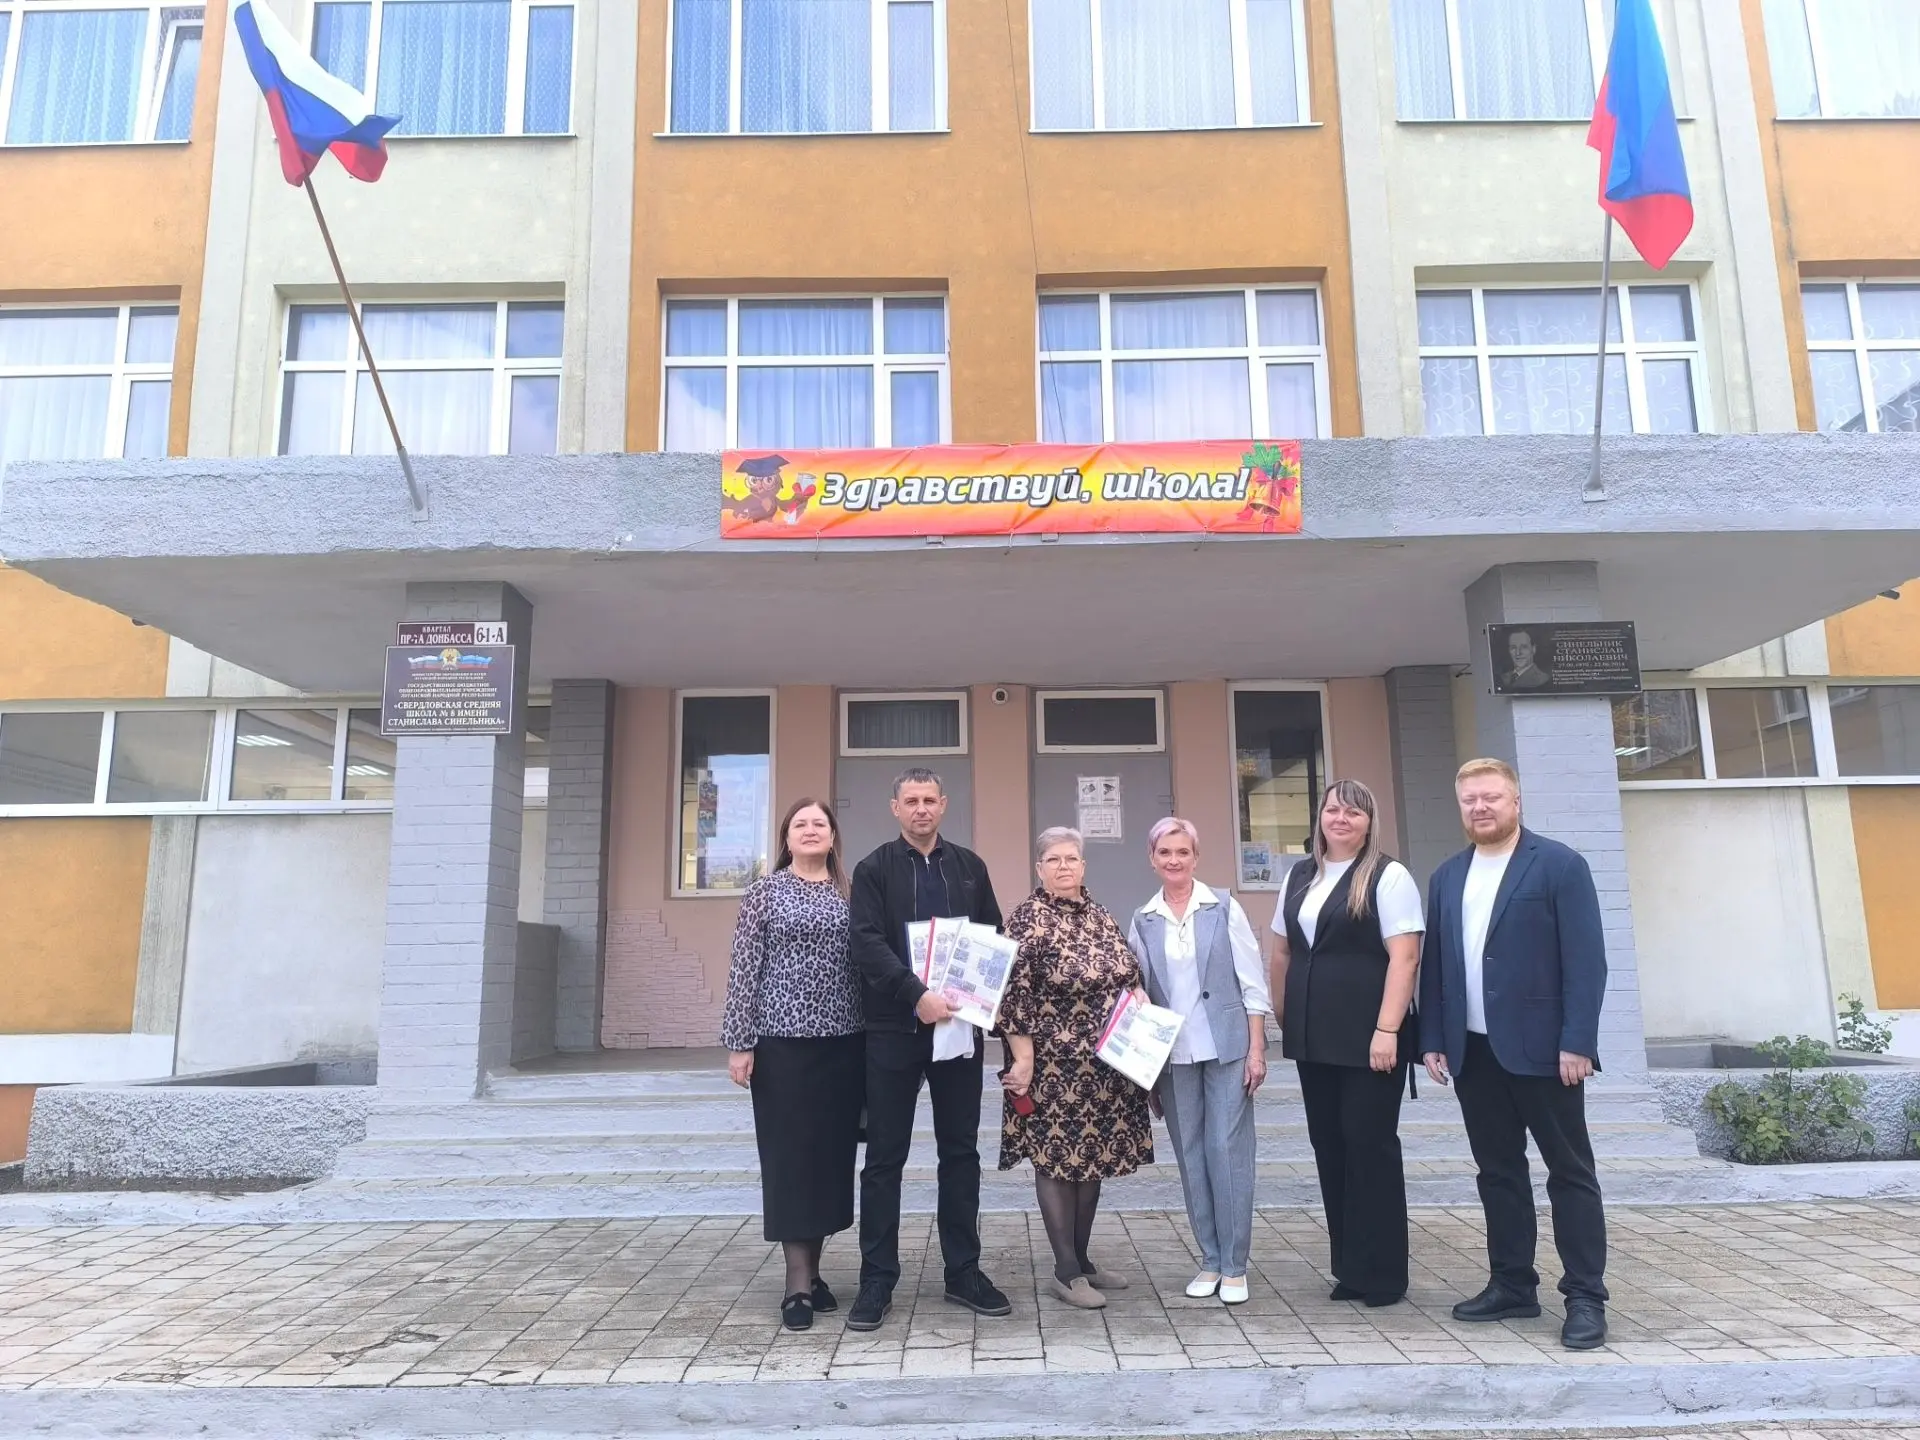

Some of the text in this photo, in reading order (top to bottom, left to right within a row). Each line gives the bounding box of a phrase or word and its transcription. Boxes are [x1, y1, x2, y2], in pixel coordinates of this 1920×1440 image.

[819, 466, 1252, 511] Здравствуй, школа!
[425, 633, 472, 645] ДОНБАССА
[1556, 640, 1623, 648] СИНЕЛЬНИК
[1556, 647, 1624, 655] СТАНИСЛАВ
[1553, 654, 1628, 662] НИКОЛАЕВИЧ
[464, 701, 502, 709] СРЕДНЯЯ
[457, 709, 488, 717] ИМЕНИ
[388, 718, 442, 726] СТАНИСЛАВА
